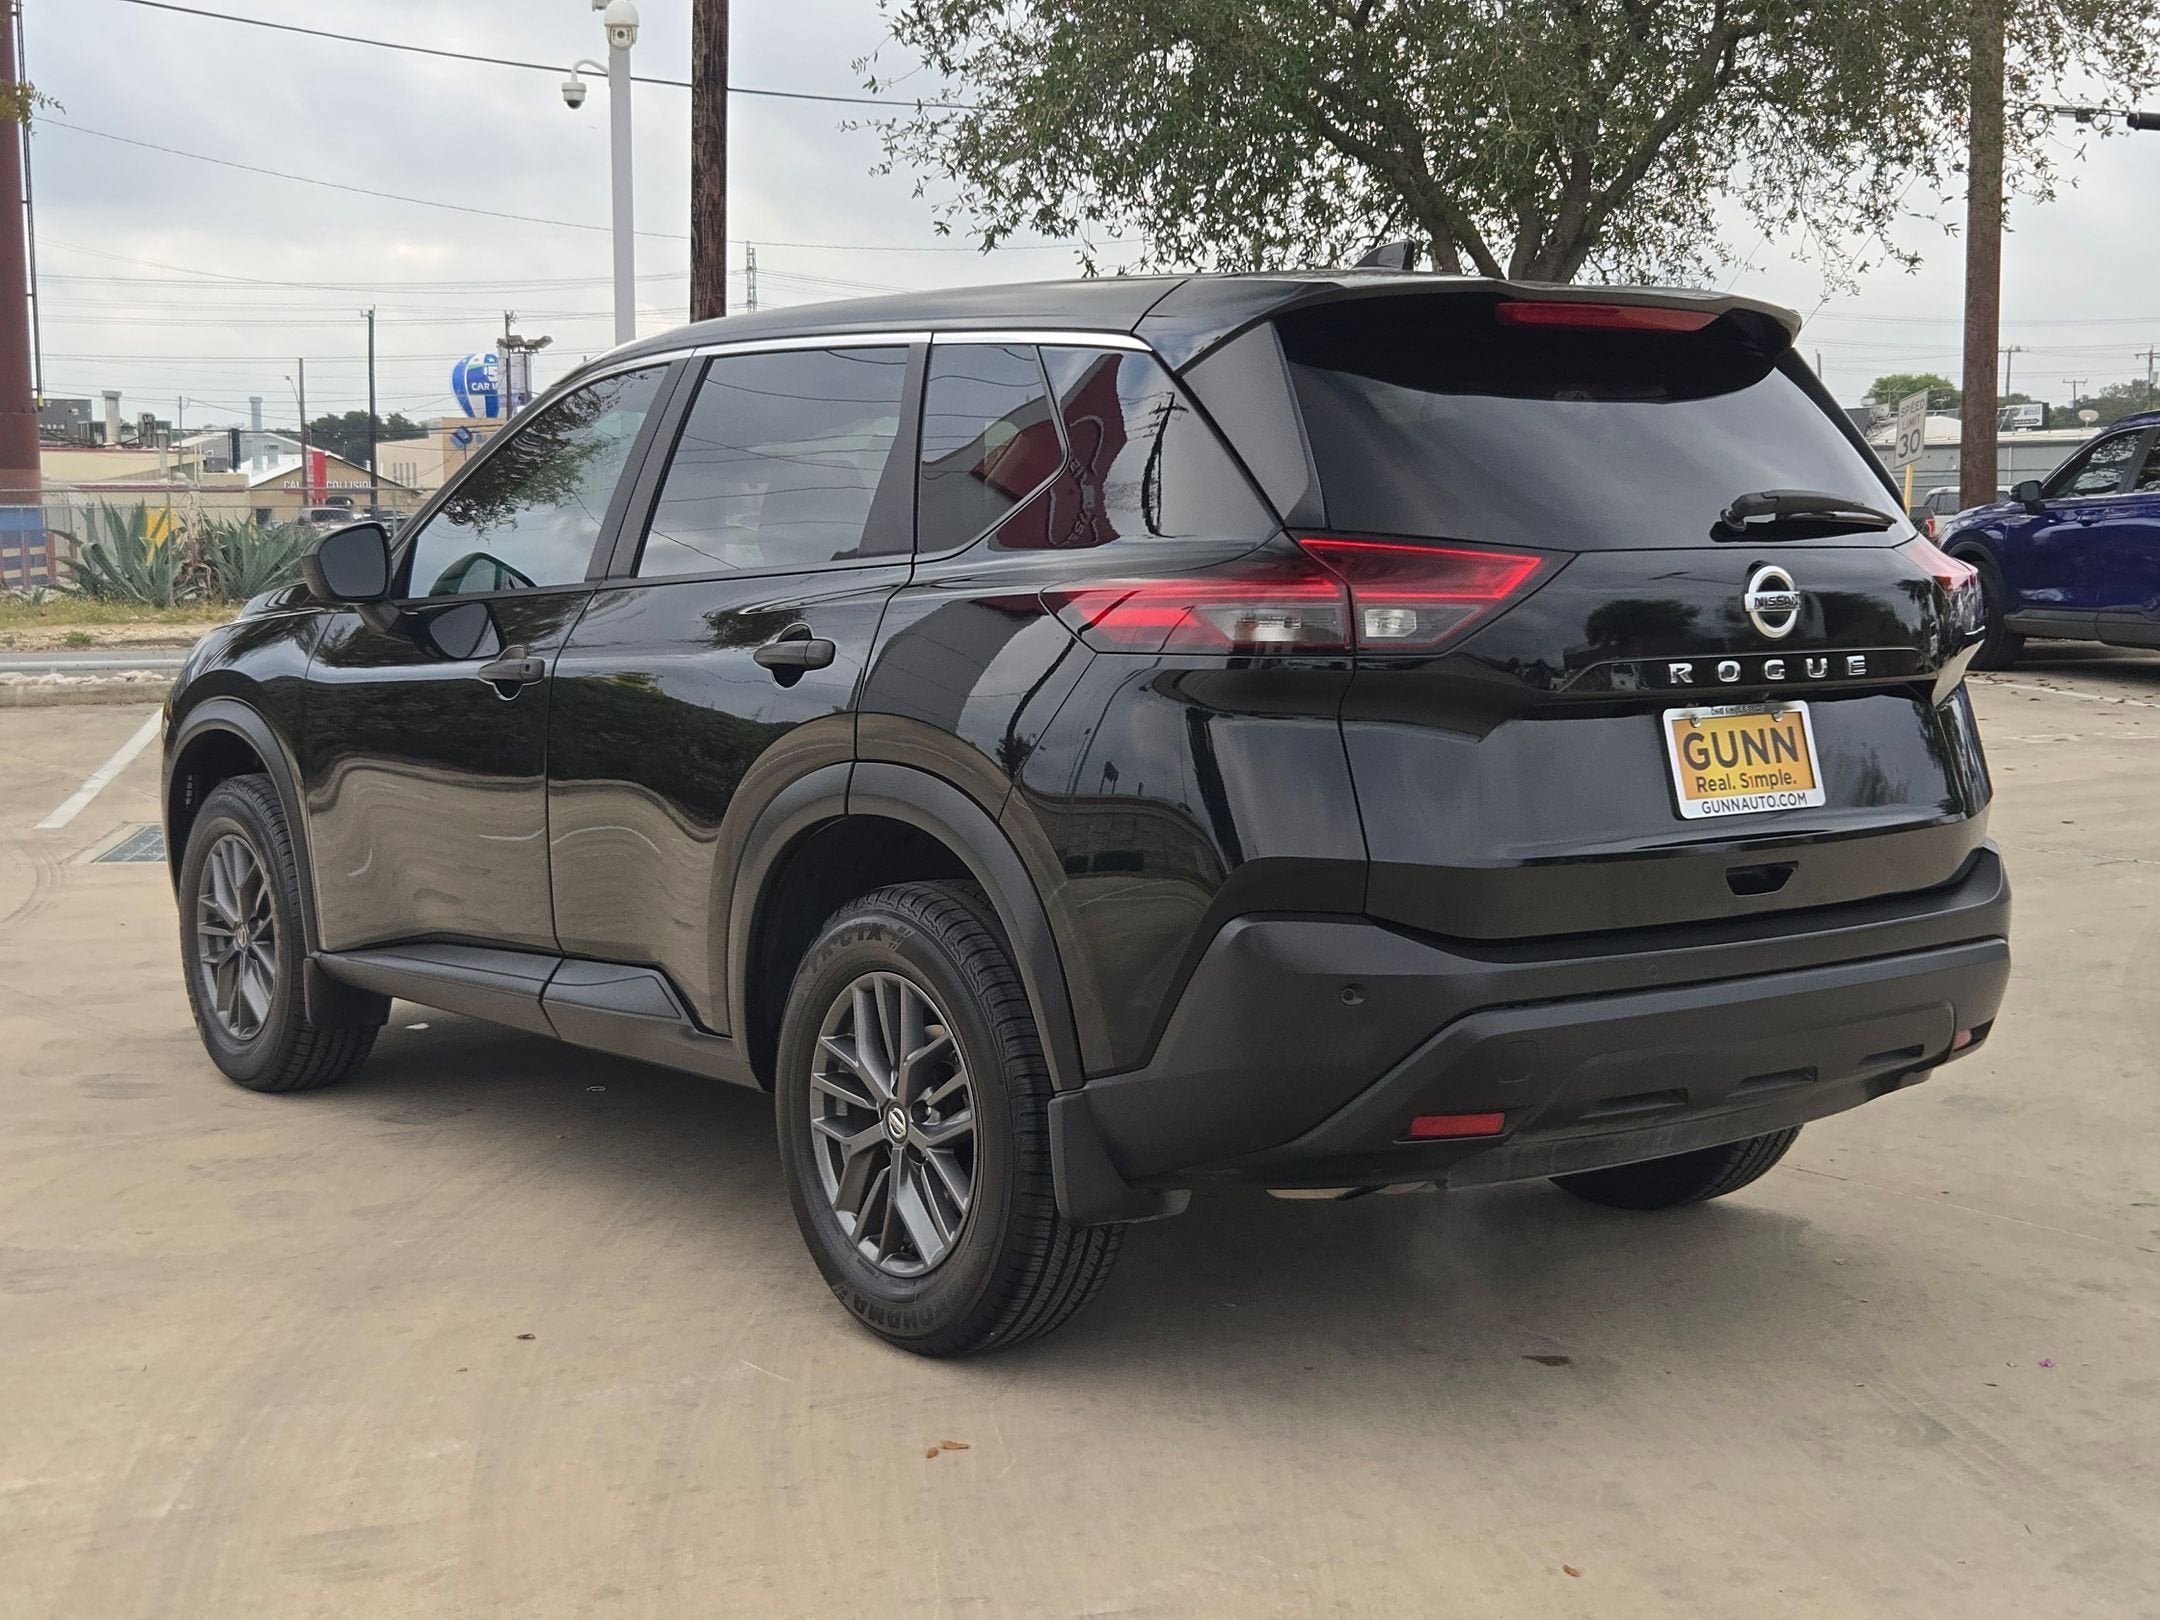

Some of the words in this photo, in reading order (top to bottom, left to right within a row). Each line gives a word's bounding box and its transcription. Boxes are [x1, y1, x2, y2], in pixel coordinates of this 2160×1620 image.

[472, 382, 490, 390] CAR
[1900, 399, 1925, 418] SPEED
[1902, 414, 1920, 431] LIMIT
[1898, 429, 1920, 458] 30
[1754, 594, 1800, 609] NISSAN
[1668, 655, 1866, 683] ROGUE
[1682, 726, 1800, 771] GUNN
[1695, 773, 1736, 793] Real.
[1701, 792, 1808, 814] GUNNAUTO.COM
